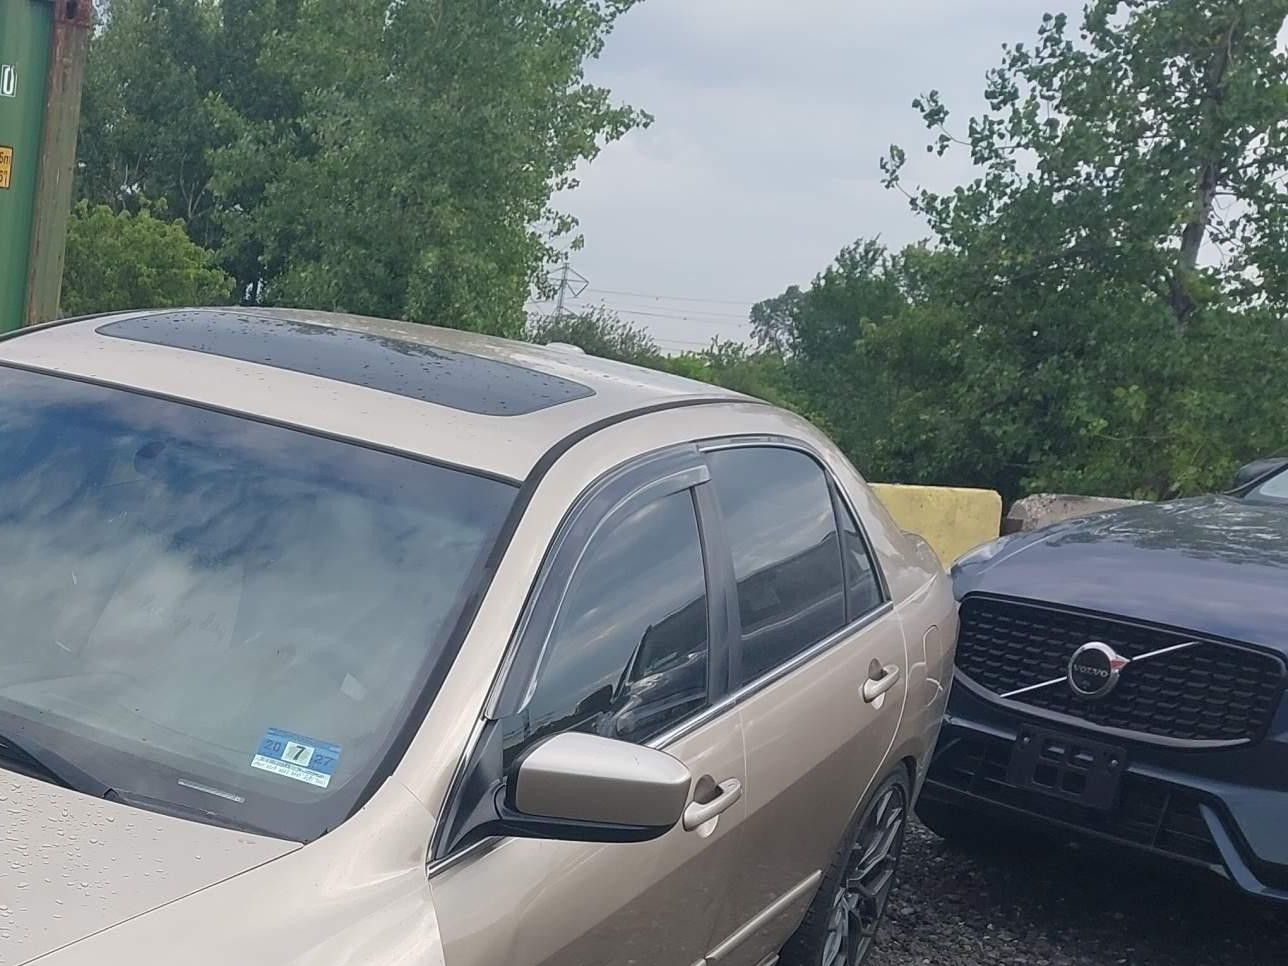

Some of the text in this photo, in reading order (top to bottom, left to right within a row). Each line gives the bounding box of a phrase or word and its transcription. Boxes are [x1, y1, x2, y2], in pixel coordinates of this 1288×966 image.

[1073, 663, 1109, 678] VOLVO
[263, 739, 281, 753] 20
[293, 745, 306, 760] 7
